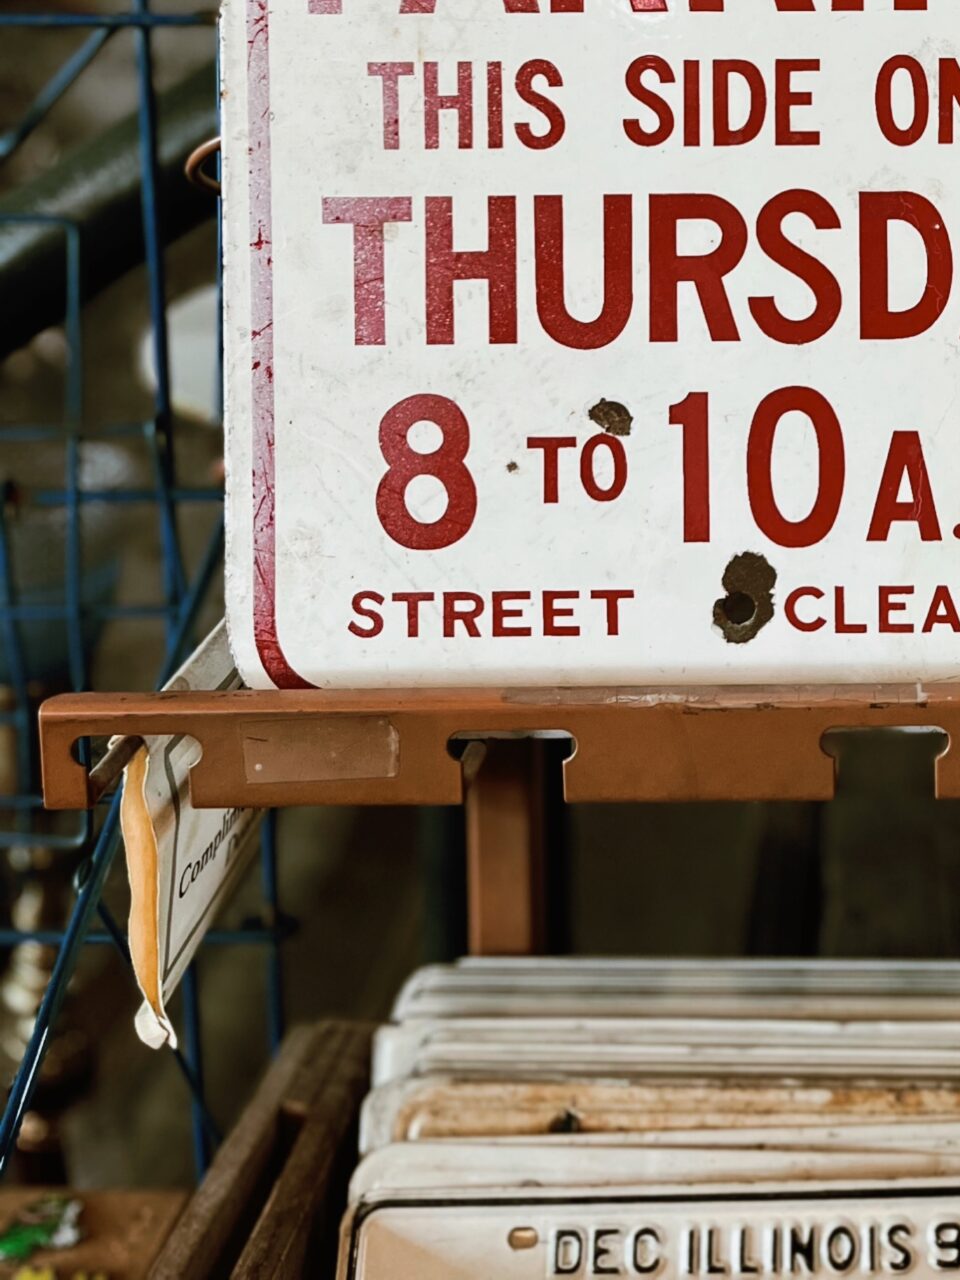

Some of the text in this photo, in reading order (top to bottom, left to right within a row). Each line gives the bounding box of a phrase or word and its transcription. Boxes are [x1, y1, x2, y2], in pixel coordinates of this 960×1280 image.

[367, 59, 566, 152] THIS
[623, 56, 821, 148] SIDE
[375, 393, 478, 551] 8
[526, 431, 628, 504] TO
[668, 385, 846, 549] 10
[347, 588, 635, 639] STREET
[553, 1227, 661, 1275] DEC
[686, 1223, 913, 1274] ILLINOIS
